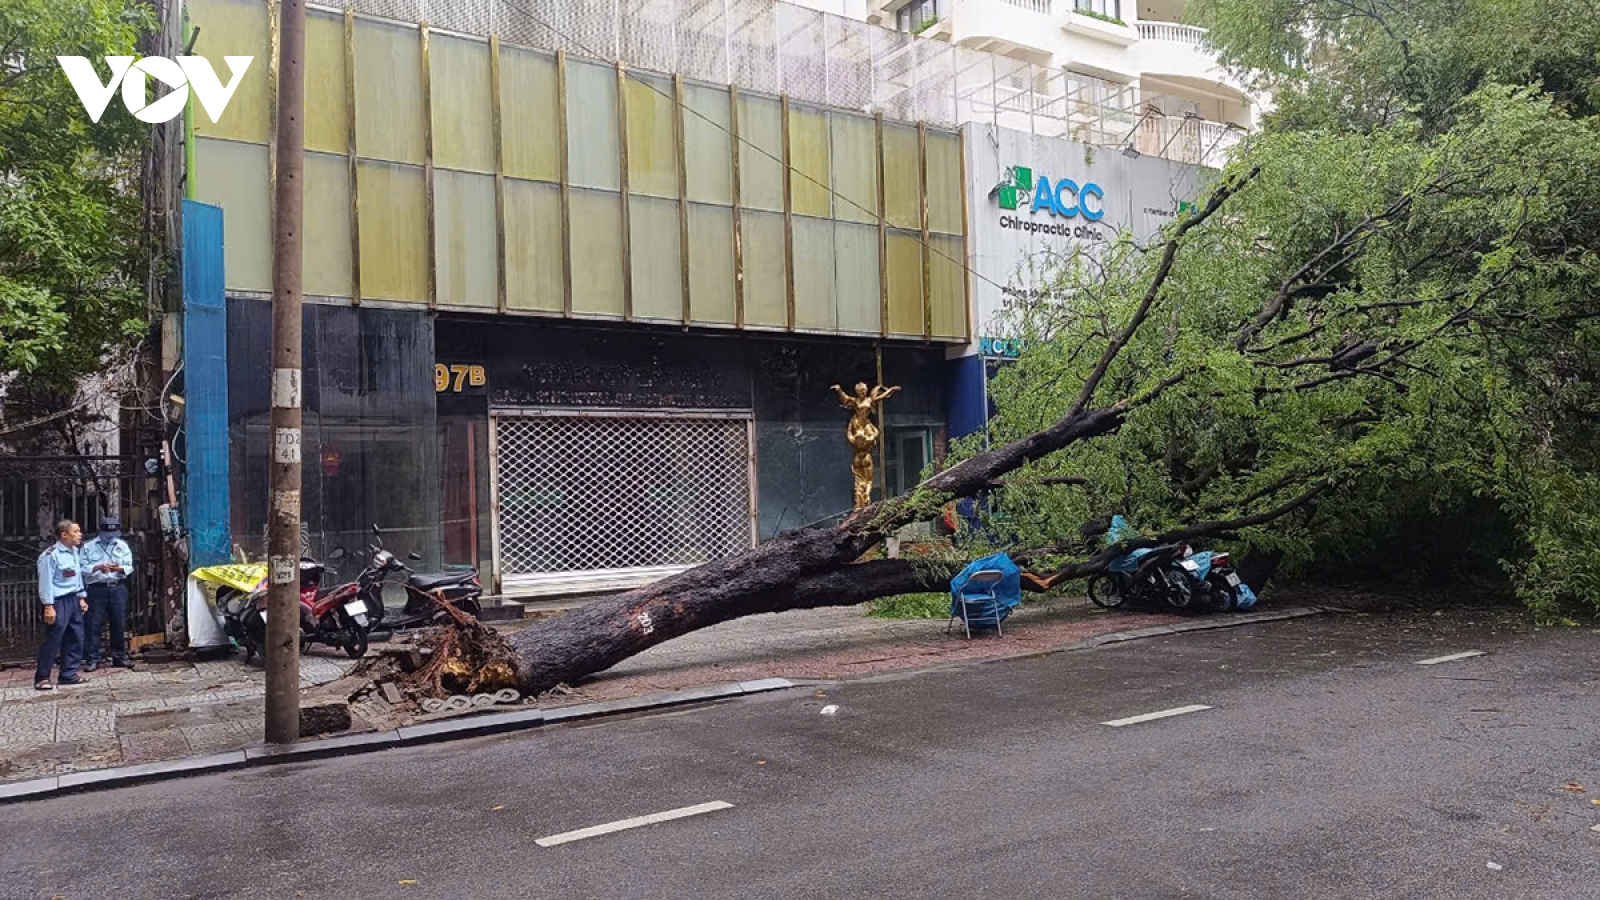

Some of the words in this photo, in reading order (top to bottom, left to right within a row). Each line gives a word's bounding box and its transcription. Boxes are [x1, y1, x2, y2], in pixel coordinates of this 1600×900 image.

[1030, 175, 1104, 221] ACC
[999, 215, 1071, 237] Chiropractic
[1074, 225, 1103, 241] Clinic
[434, 363, 486, 392] 97B
